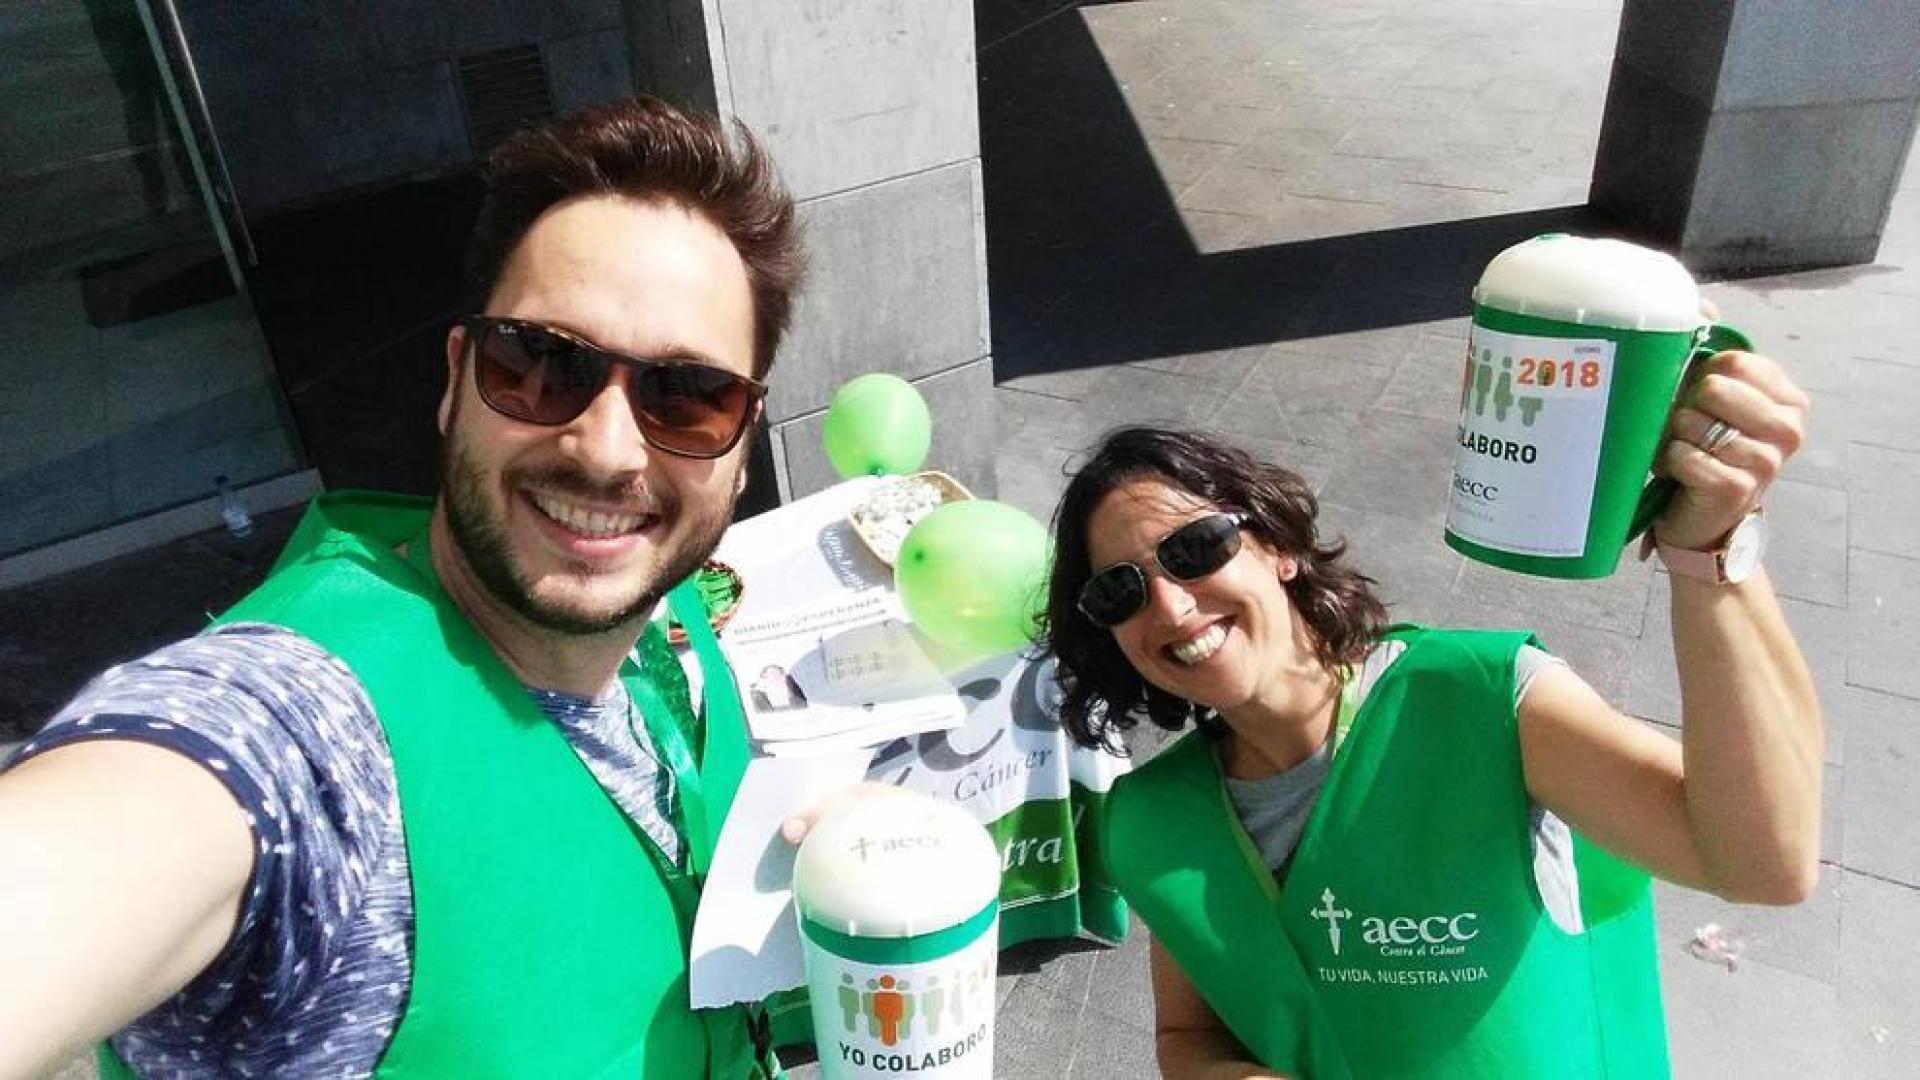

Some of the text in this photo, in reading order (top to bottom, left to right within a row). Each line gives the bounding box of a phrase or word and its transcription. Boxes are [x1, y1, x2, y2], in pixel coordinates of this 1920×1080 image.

[1516, 357, 1601, 389] 2018
[1457, 424, 1538, 465] LABORO
[1000, 834, 1064, 872] tra
[1361, 912, 1480, 944] aecc
[1318, 968, 1336, 982] TU
[1378, 969, 1450, 985] NUESTRA
[1451, 966, 1489, 982] VIDA
[839, 1023, 987, 1073] YO COLABORO
